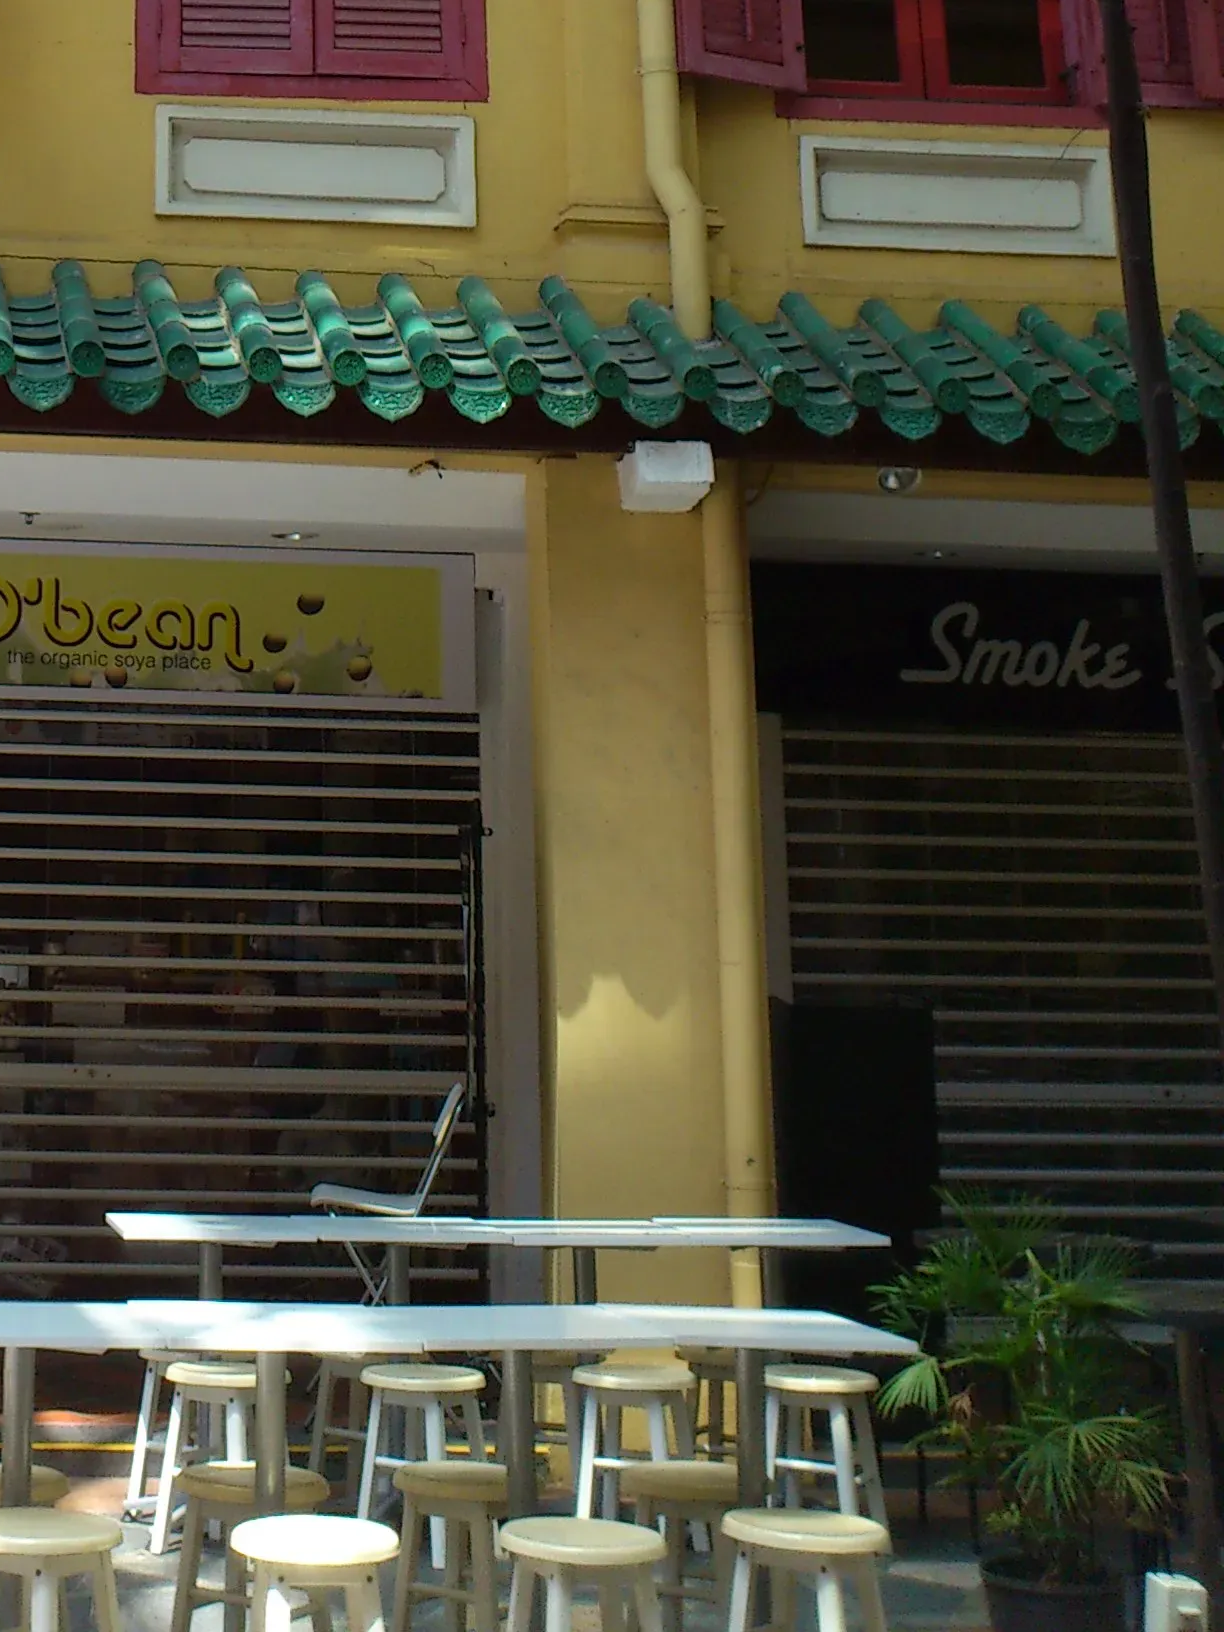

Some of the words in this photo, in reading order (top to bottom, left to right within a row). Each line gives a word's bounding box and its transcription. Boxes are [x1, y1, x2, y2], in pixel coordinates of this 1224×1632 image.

[8, 649, 34, 664] the
[41, 650, 107, 669] organic
[115, 652, 155, 671] soya
[162, 653, 211, 672] place
[899, 601, 1143, 690] Smoke
